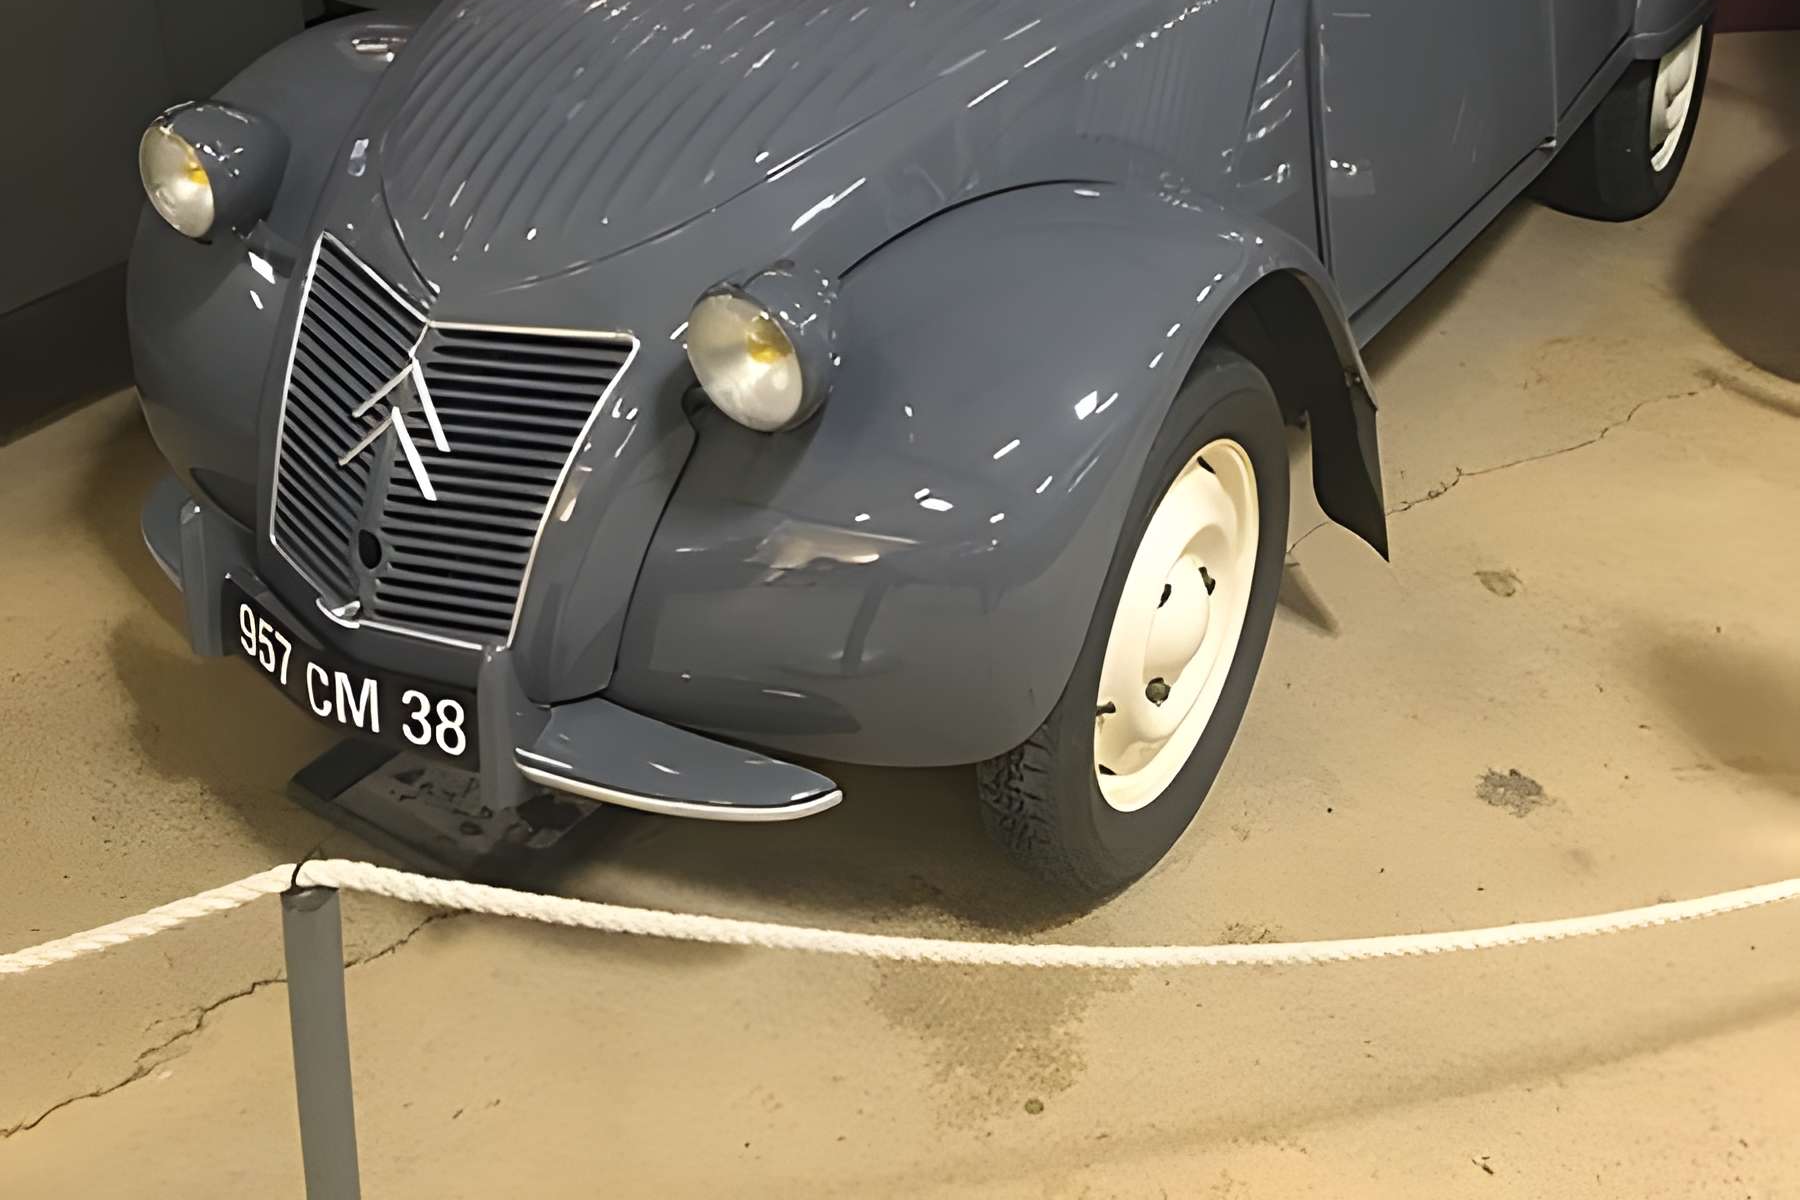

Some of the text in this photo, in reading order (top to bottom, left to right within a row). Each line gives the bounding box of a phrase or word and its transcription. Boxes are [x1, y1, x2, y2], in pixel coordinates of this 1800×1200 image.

[239, 603, 467, 756] 957 CM 38
